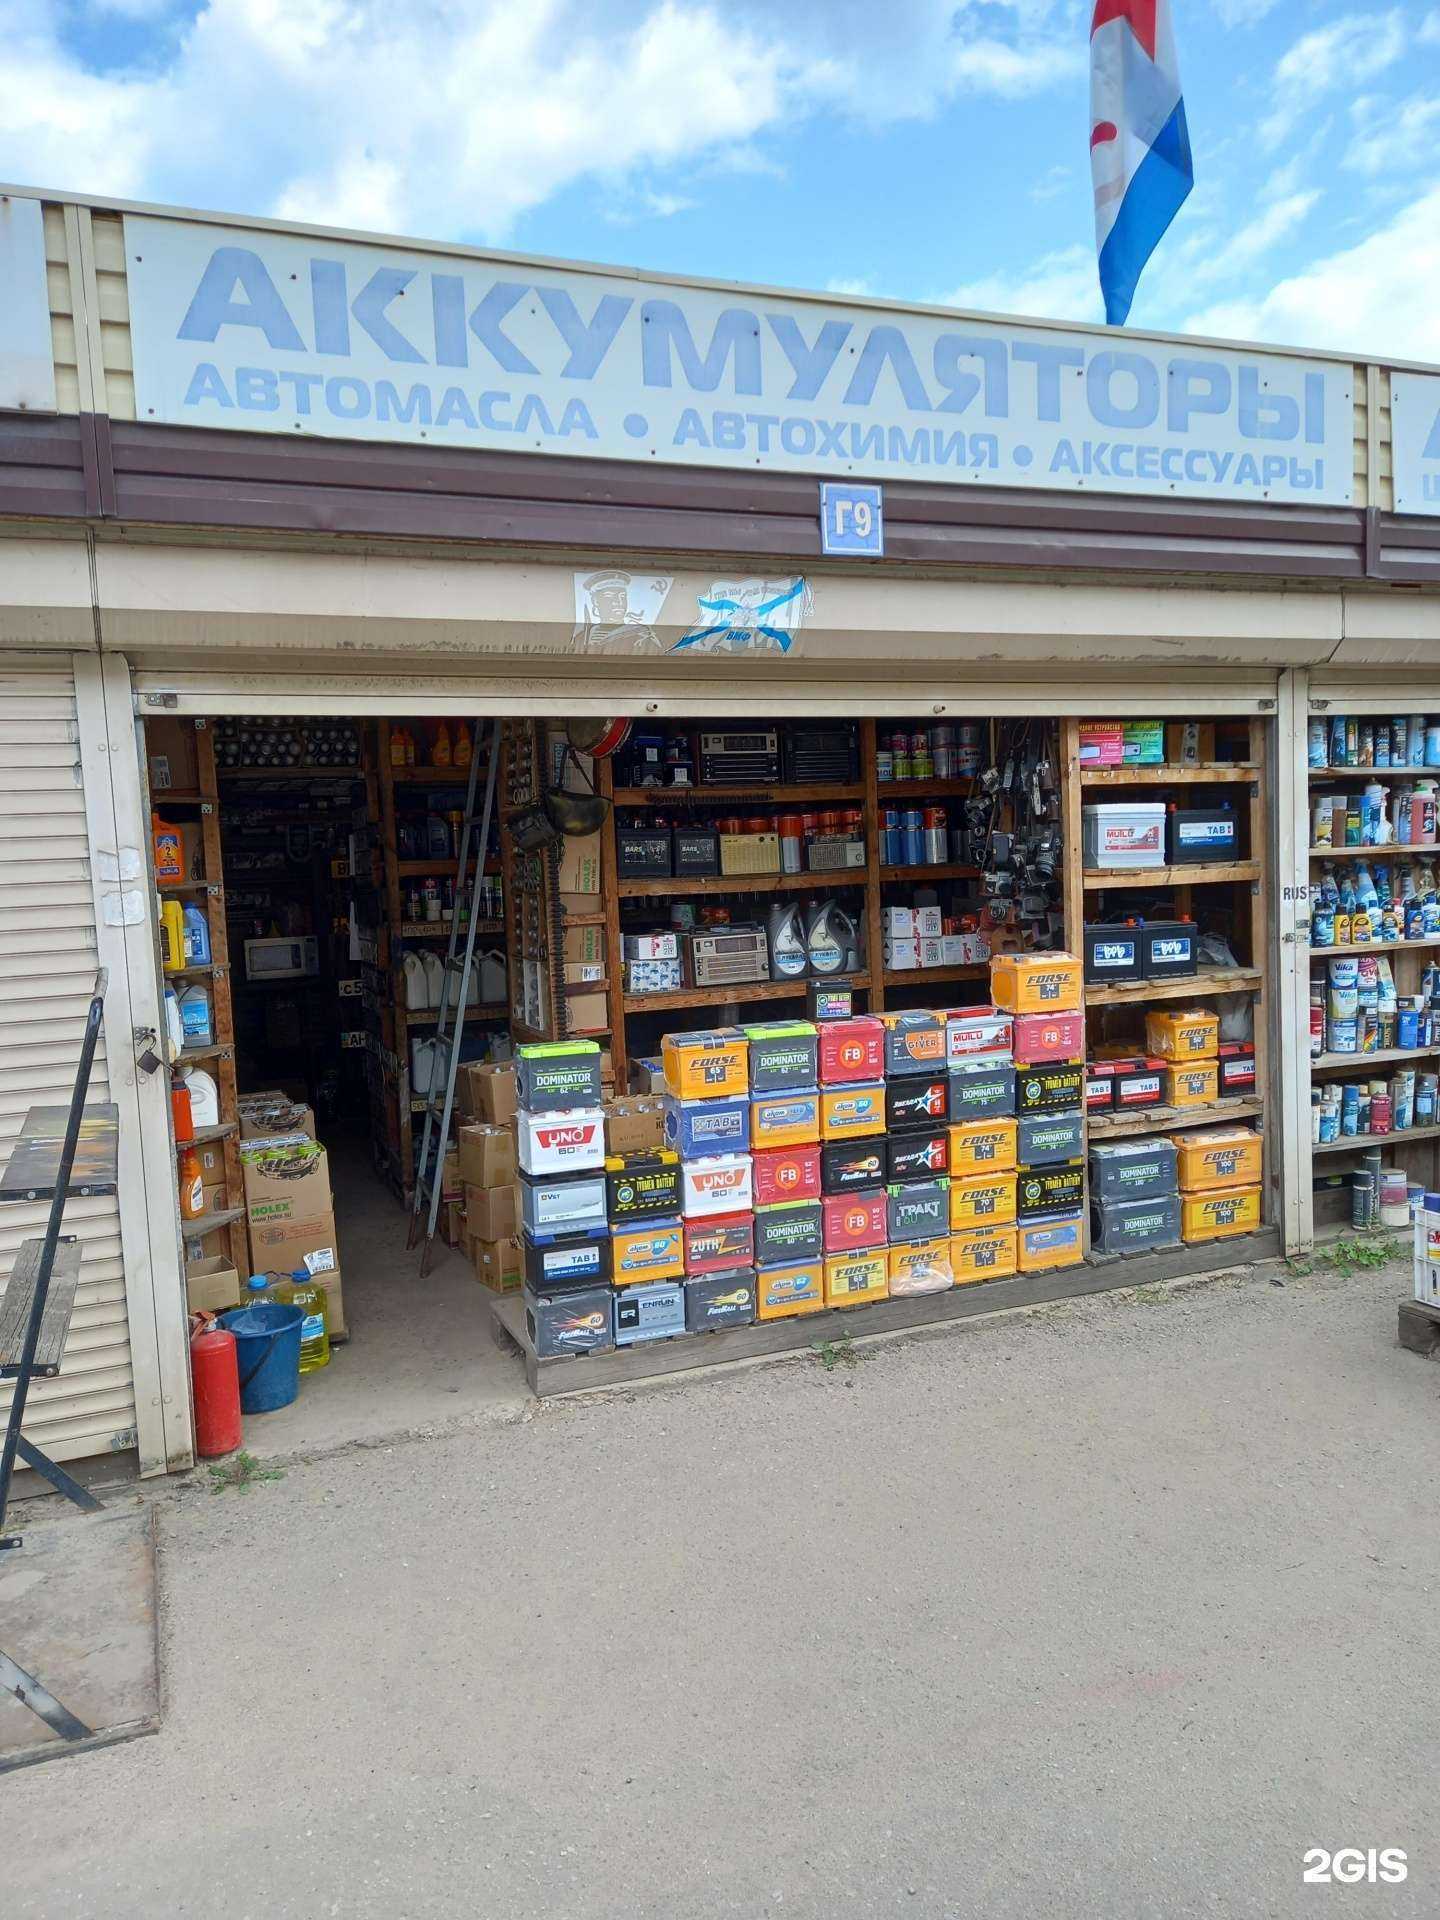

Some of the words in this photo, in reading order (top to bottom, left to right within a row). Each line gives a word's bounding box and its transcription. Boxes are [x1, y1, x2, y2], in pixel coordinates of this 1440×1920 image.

[176, 246, 1325, 444] АККУМУЛЯТОРЫ
[184, 362, 598, 440] АВТОМАСЛА
[673, 408, 999, 470] АВТОХИМИЯ
[1049, 438, 1324, 491] АКСЕССУАРЫ
[835, 499, 873, 538] Г9
[1207, 825, 1226, 835] TAB
[1283, 886, 1308, 901] RUS
[1335, 963, 1353, 971] Vika
[1027, 973, 1072, 985] FORSE
[1045, 1031, 1058, 1042] FB
[1178, 1026, 1216, 1038] FORSE
[691, 1055, 739, 1068] FORSE
[761, 1053, 809, 1067] DOMINATOR
[844, 1048, 861, 1061] FB
[537, 1072, 591, 1086] DOMINATOR
[1177, 1071, 1217, 1082] FORSE
[962, 1085, 1006, 1099] DOMINATOR
[1090, 1085, 1105, 1094] TAB
[1140, 1083, 1154, 1091] TAB
[706, 1117, 730, 1129] TAB
[548, 1127, 584, 1145] UNO
[962, 1133, 1008, 1146] FORSE
[1032, 1131, 1073, 1145] DOMINATOR
[1204, 1148, 1247, 1162] FORSE
[780, 1169, 797, 1182] FB
[1120, 1165, 1160, 1179] DOMINATOR
[702, 1171, 736, 1189] UNO
[962, 1187, 1007, 1201] FORSE
[250, 1202, 289, 1217] HOLEX
[1204, 1198, 1247, 1212] FORSE
[848, 1216, 865, 1228] FB
[1124, 1216, 1163, 1230] DOMINATOR
[767, 1224, 815, 1239] DOMINATOR
[962, 1239, 1008, 1253] FORSE
[571, 1254, 590, 1264] TAB
[899, 1251, 941, 1265] FORSE
[835, 1263, 880, 1277] FORSE
[642, 1298, 675, 1309] ENRUN
[620, 1309, 636, 1319] ER
